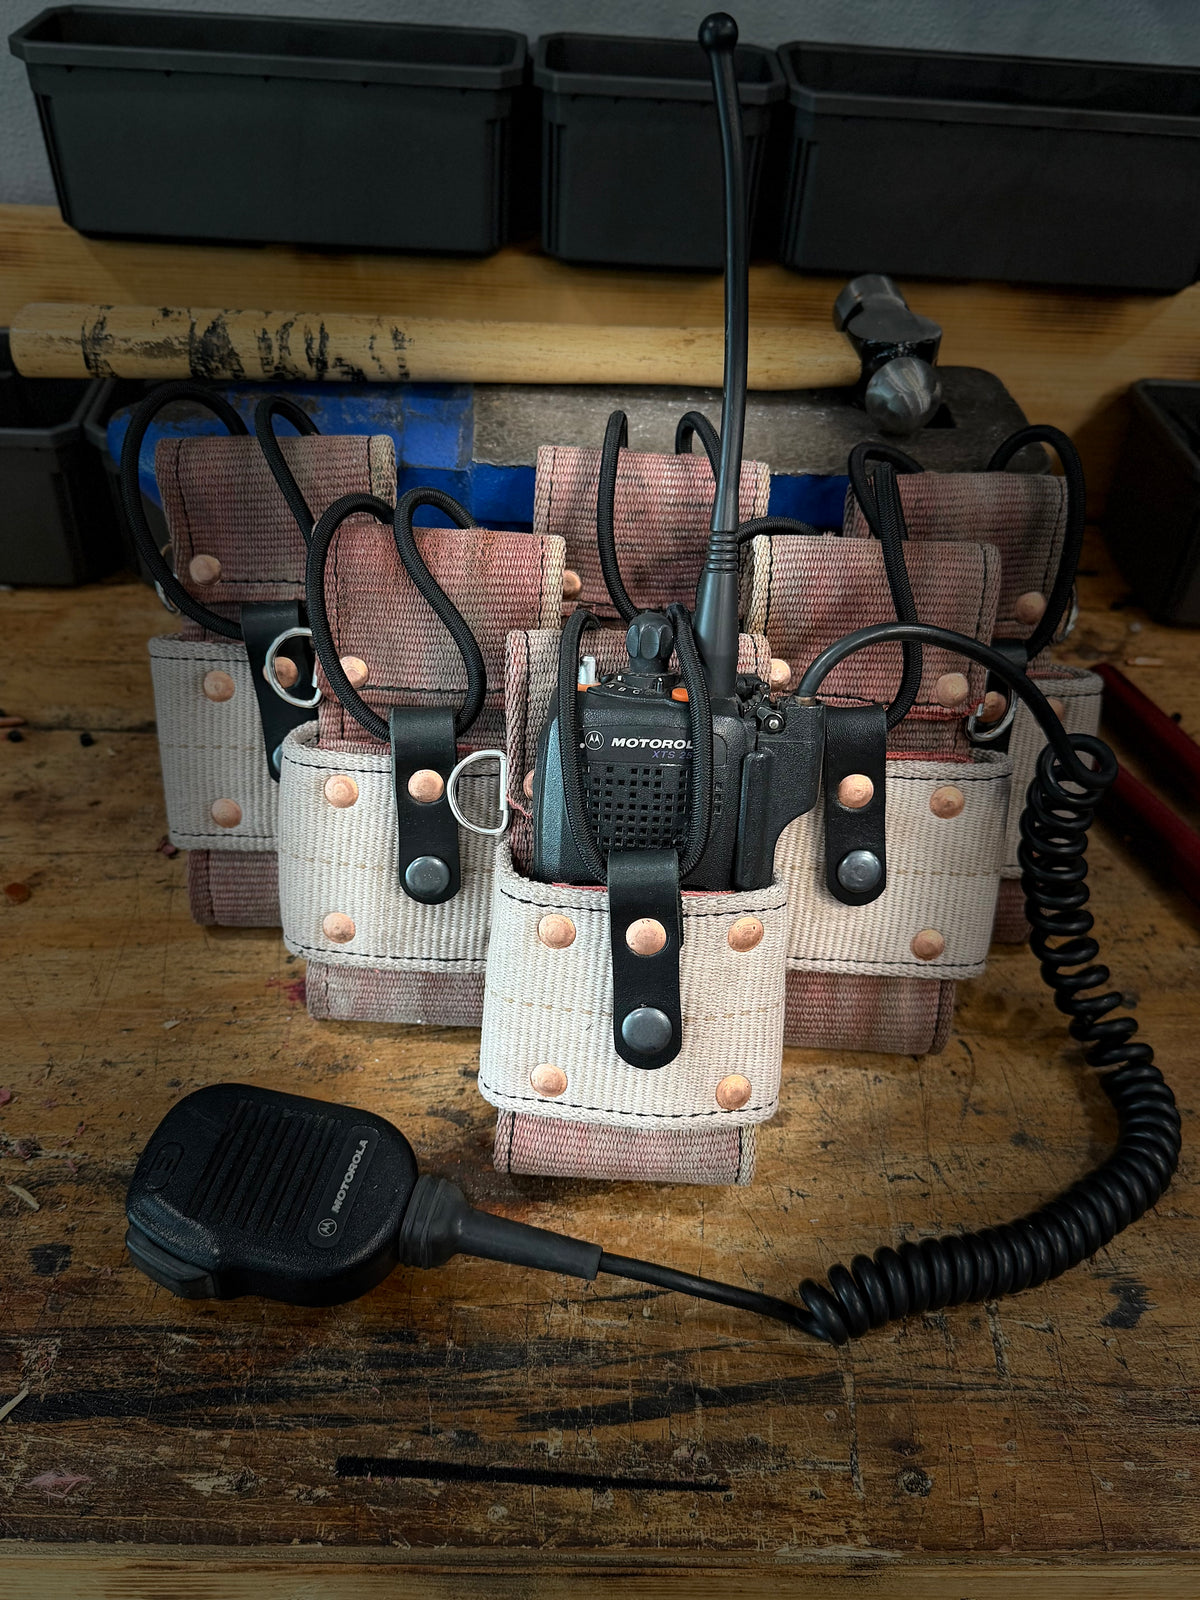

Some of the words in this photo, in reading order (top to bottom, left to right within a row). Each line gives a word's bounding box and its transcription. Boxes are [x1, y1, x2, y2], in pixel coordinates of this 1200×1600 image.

[611, 737, 693, 749] MOTOROL
[651, 750, 676, 759] XTS
[679, 751, 693, 760] 25
[331, 1139, 369, 1214] MOTOROLA
